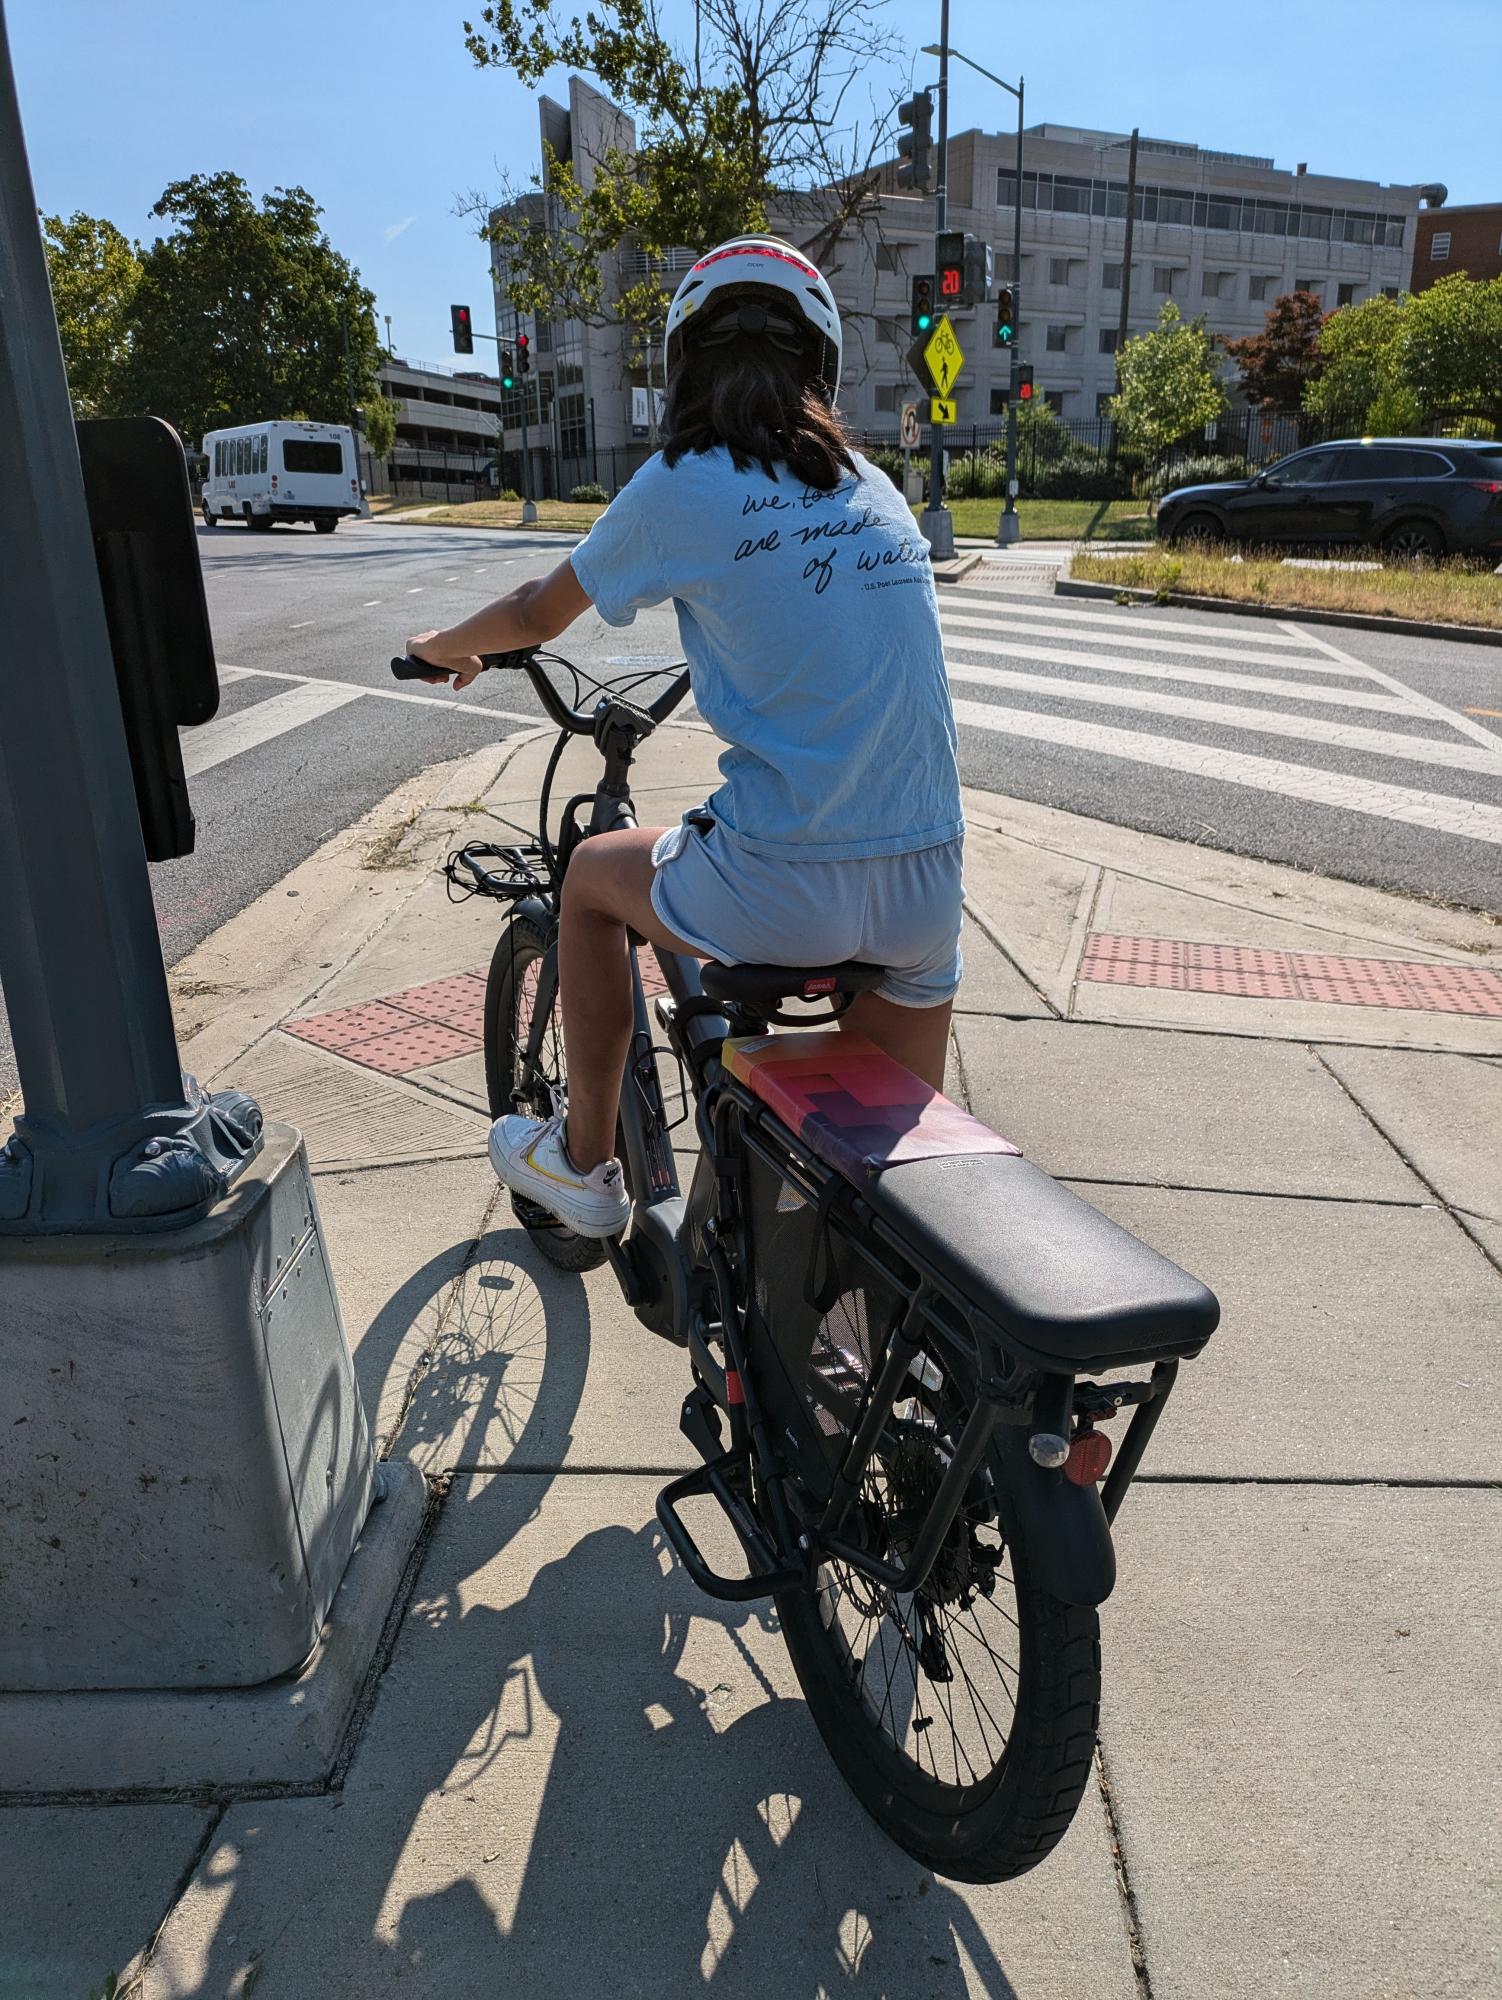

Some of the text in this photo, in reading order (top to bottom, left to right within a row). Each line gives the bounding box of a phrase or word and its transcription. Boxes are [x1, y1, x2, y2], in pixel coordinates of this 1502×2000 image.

[943, 271, 959, 294] 20
[734, 508, 890, 561] are made
[803, 548, 837, 594] of
